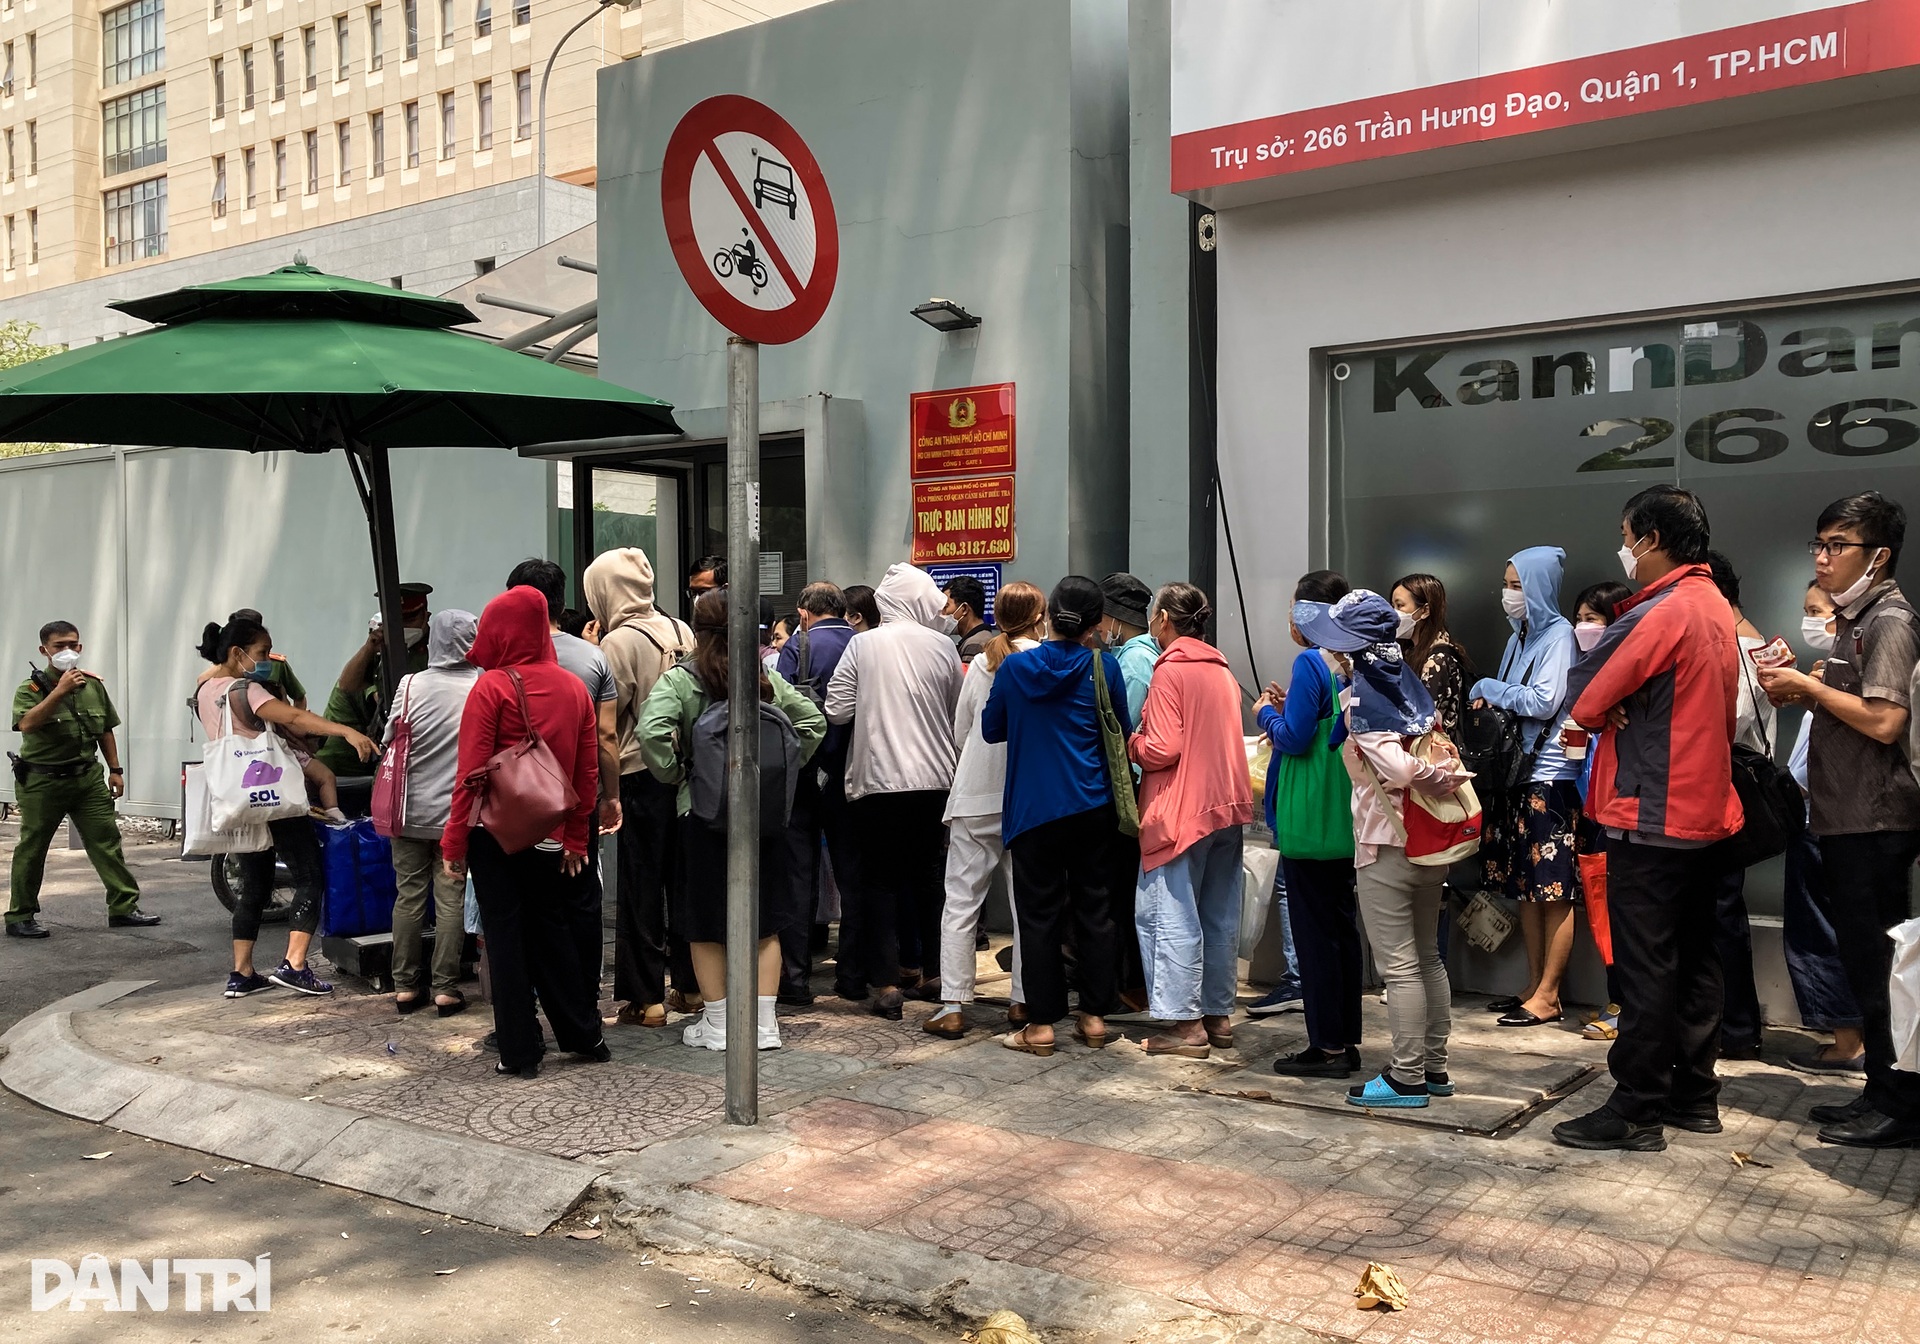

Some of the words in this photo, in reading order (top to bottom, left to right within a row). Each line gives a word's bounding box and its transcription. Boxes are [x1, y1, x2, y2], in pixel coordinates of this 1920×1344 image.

[1210, 146, 1248, 170] Trụ
[1255, 135, 1295, 161] sở:
[1303, 124, 1347, 153] 266
[1355, 111, 1412, 143] Trần
[1421, 101, 1496, 132] Hưng
[1505, 90, 1570, 119] Đạo,
[1580, 71, 1660, 102] Quận
[1672, 61, 1697, 89] 1,
[1707, 31, 1837, 80] TP.HCM
[918, 435, 934, 447] CÔNG
[934, 436, 942, 446] AN
[942, 433, 961, 445] THÀNH
[961, 430, 973, 443] PHỐ
[982, 429, 992, 441] CHÍ
[992, 430, 1008, 441] MINH
[1576, 398, 1920, 472] 266
[918, 508, 942, 536] TRỰC
[945, 509, 965, 531] BAN
[968, 503, 992, 529] HÌNH
[995, 503, 1010, 532] SỰ
[936, 538, 1010, 557] 069.3187.680
[250, 789, 280, 803] SOL
